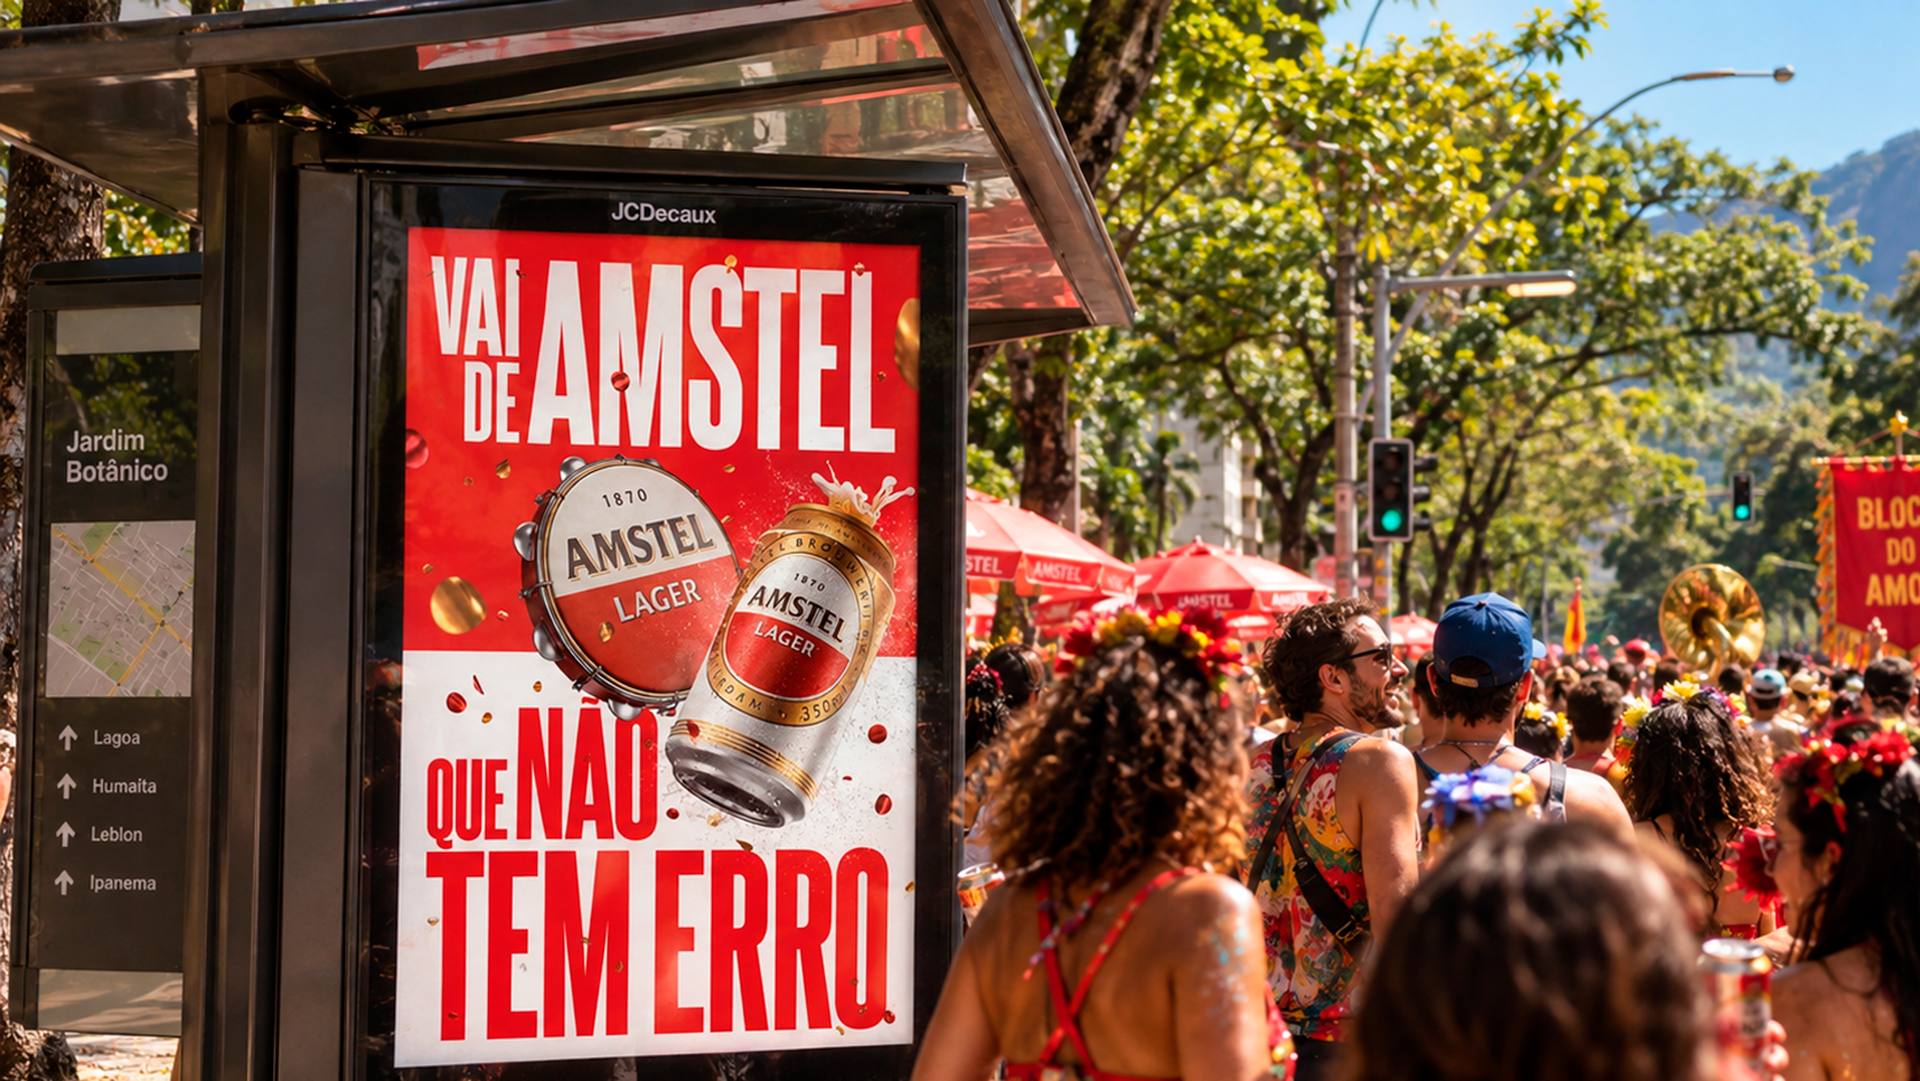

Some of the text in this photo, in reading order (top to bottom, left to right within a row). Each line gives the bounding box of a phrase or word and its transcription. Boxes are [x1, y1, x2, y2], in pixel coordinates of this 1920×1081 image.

[611, 202, 717, 225] JCDecaux
[431, 256, 520, 357] VAI
[464, 260, 896, 453] DE AMSTEL
[66, 428, 145, 453] Jardim
[66, 458, 169, 483] Botânico
[602, 488, 648, 508] 1870
[1857, 495, 1920, 530] BLOC
[567, 513, 717, 582] AMSTEL
[1886, 535, 1917, 567] DO
[793, 573, 826, 592] 1870
[1032, 561, 1082, 583] AMSTEL
[613, 578, 703, 623] LAGER
[1865, 571, 1920, 607] AMO
[747, 585, 847, 643] AMSTEL
[754, 621, 815, 658] LAGER
[94, 729, 141, 749] Lagoa
[92, 777, 157, 794] Humaita
[426, 696, 659, 849] QUE NÃO
[91, 826, 143, 843] Leblon
[90, 874, 157, 894] Ipanema
[426, 847, 889, 1041] TEM ERRO
